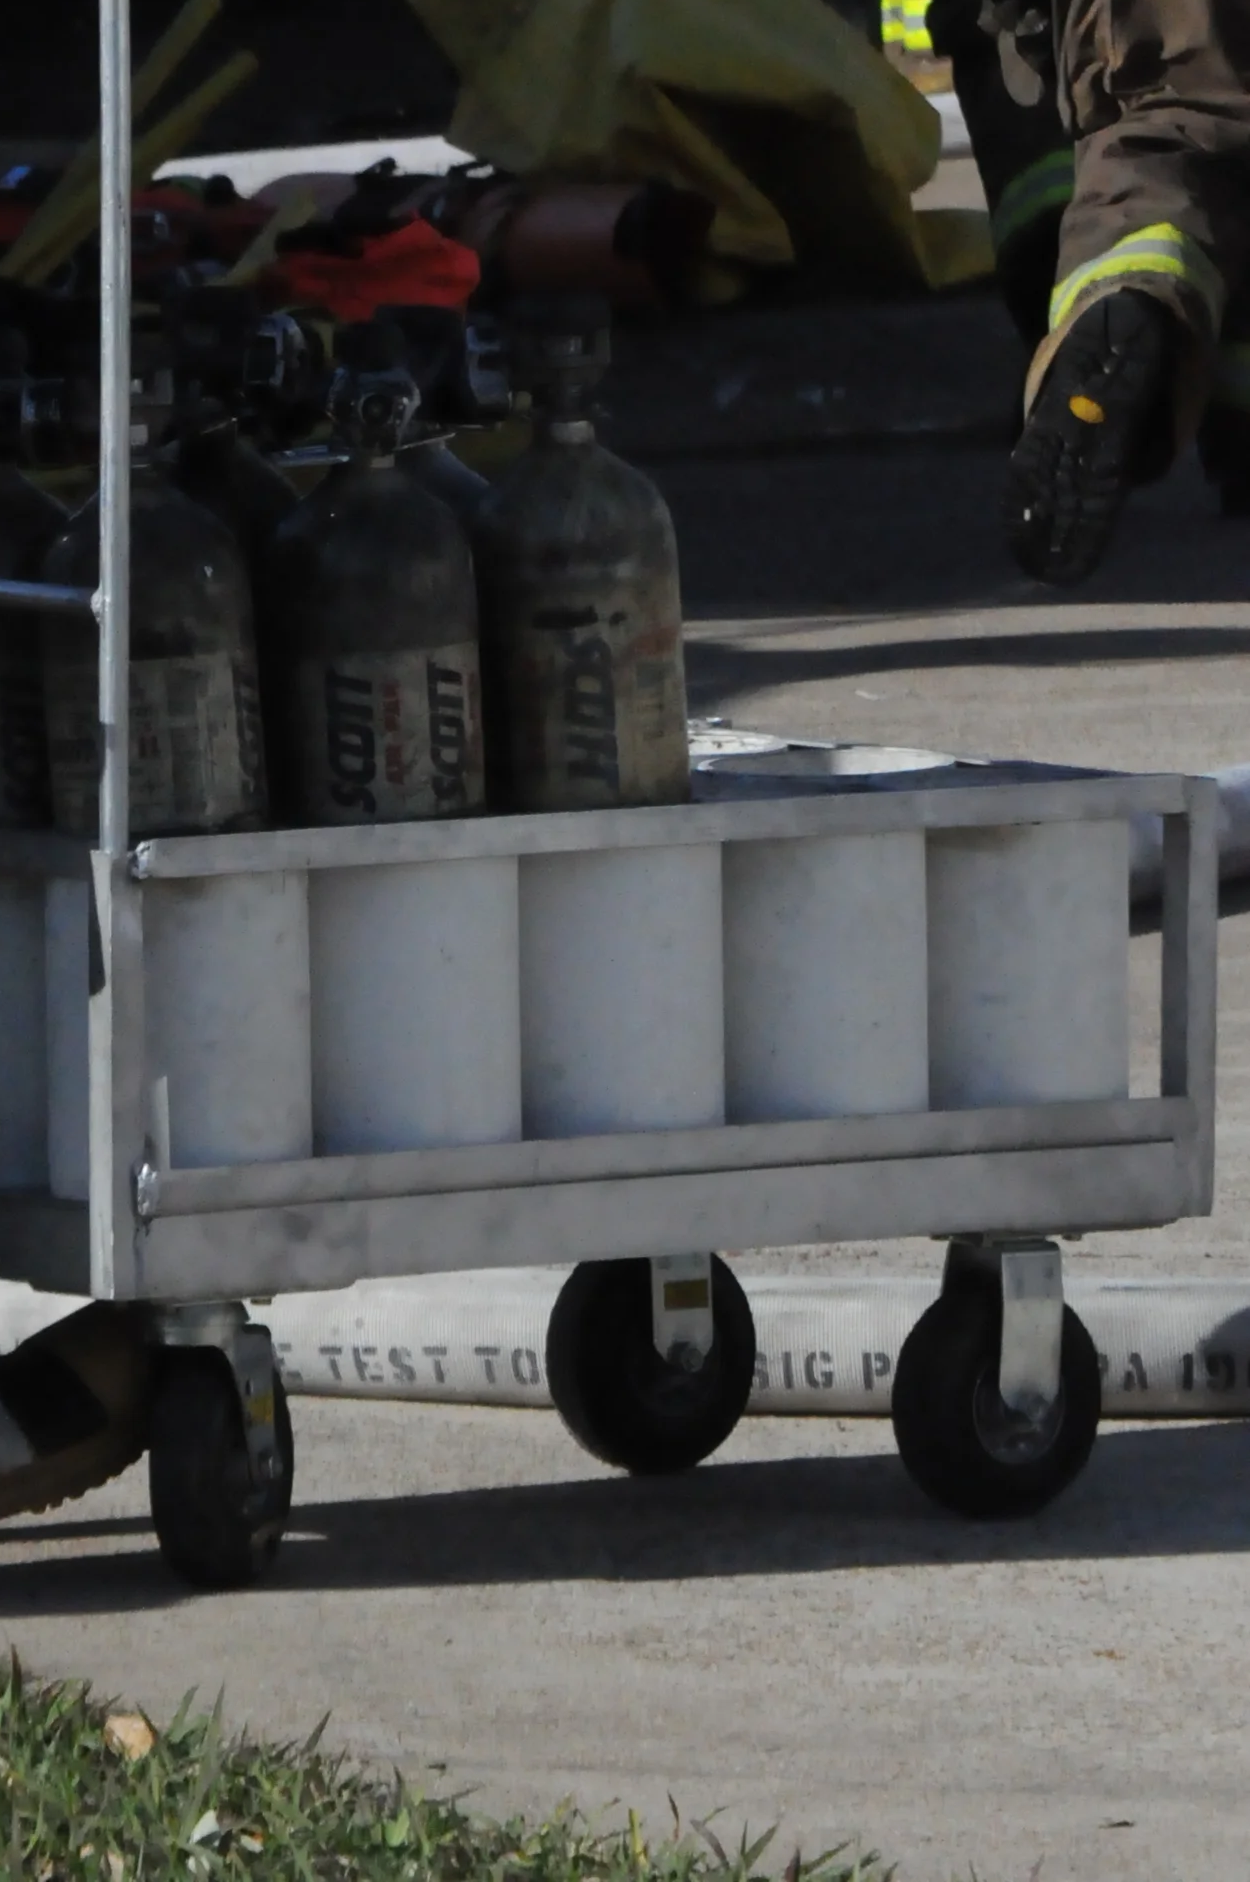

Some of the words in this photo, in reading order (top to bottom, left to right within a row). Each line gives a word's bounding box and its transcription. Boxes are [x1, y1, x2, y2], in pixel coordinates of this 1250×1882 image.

[324, 665, 376, 814] SCOTT
[427, 659, 466, 808] SCOTT
[318, 1346, 448, 1385] TEST
[474, 1346, 538, 1387] TO
[1181, 1352, 1250, 1393] 19
